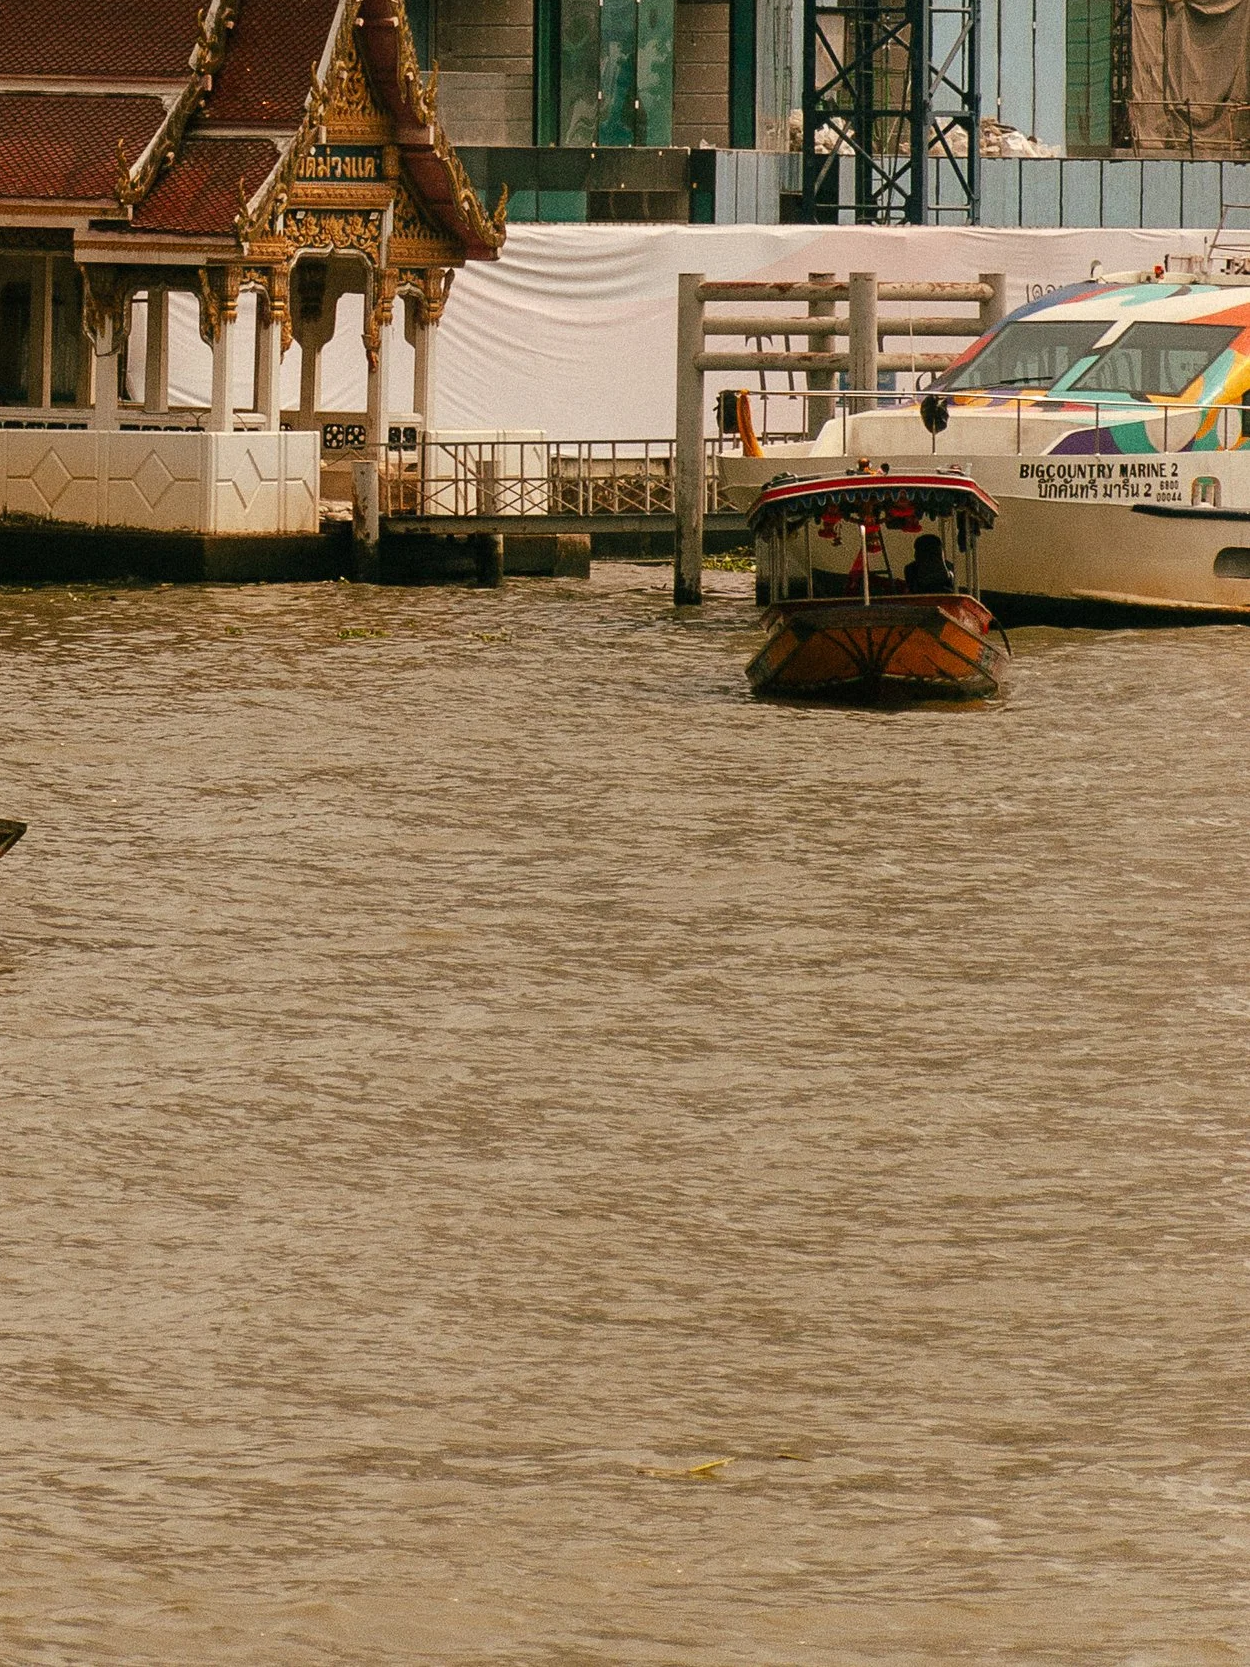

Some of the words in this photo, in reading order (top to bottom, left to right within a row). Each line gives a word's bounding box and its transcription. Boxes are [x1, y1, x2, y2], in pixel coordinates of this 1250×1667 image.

[1019, 463, 1115, 479] BIGCOUNTRY
[1118, 462, 1167, 478] MARINE
[1170, 462, 1179, 475] 2
[1143, 483, 1152, 498] 2
